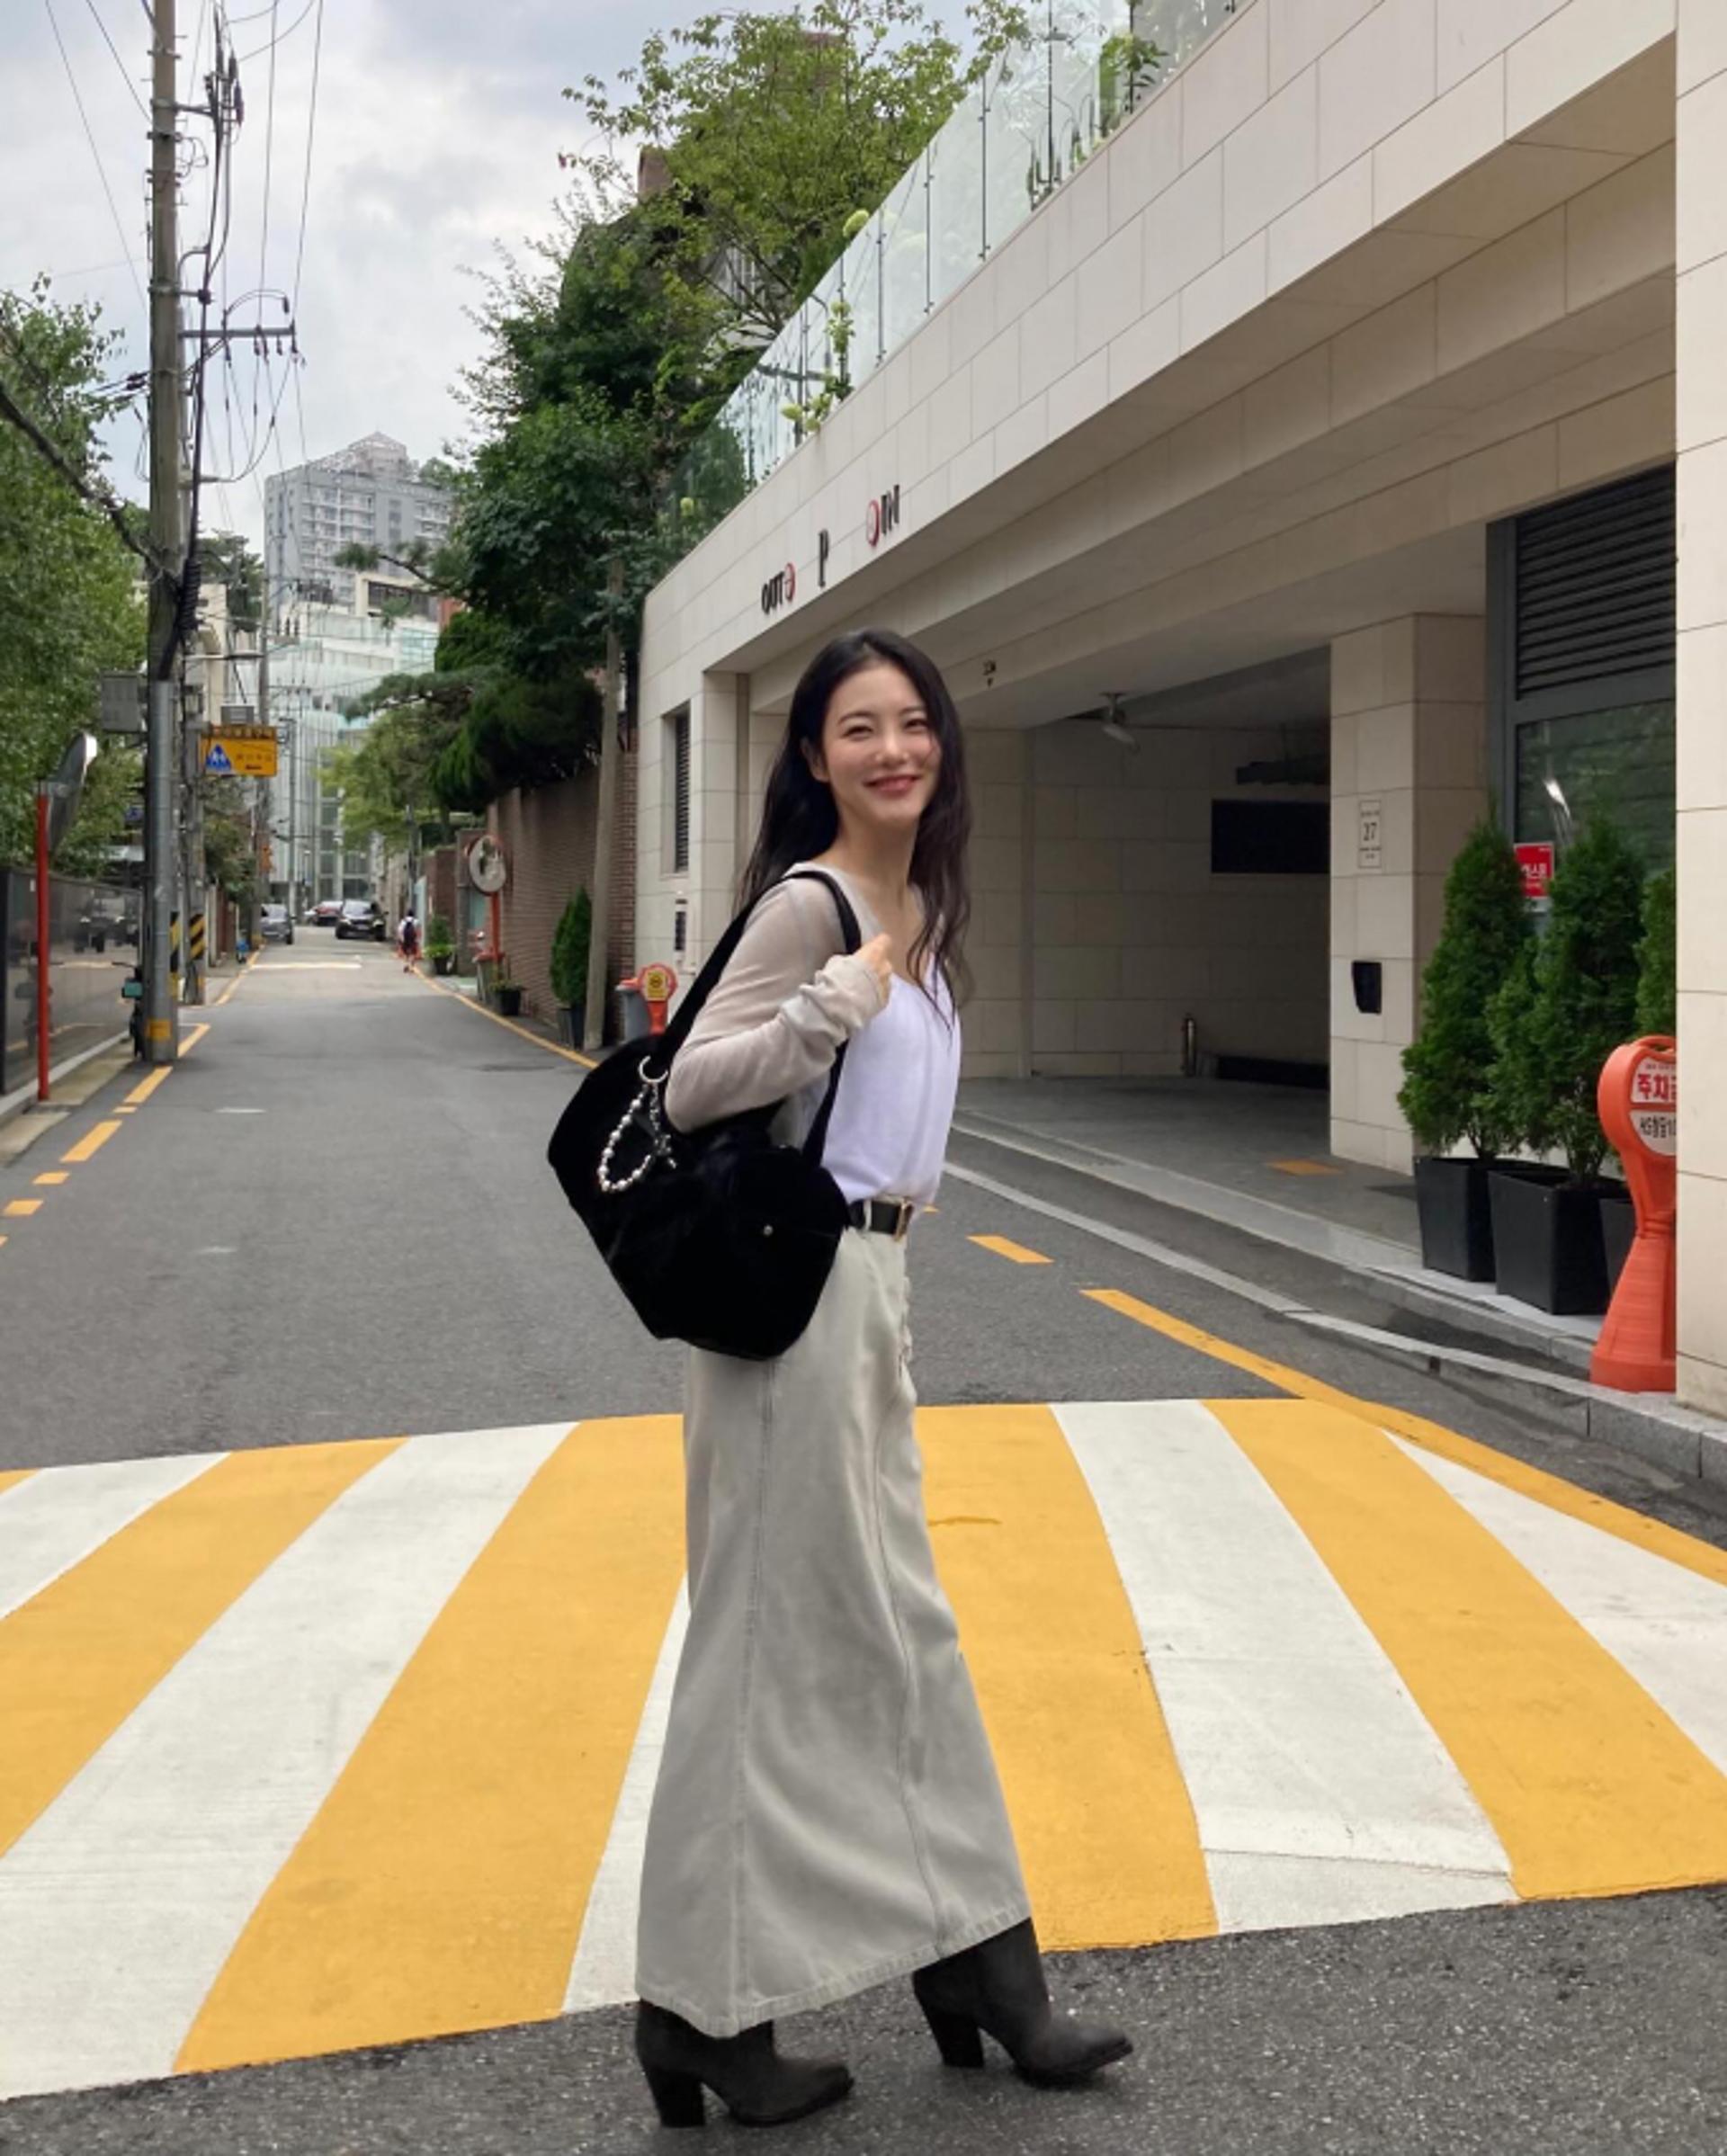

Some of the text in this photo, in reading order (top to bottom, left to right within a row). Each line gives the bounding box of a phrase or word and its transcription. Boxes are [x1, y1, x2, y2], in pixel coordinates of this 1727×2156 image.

[761, 484, 900, 614] OUT P IN
